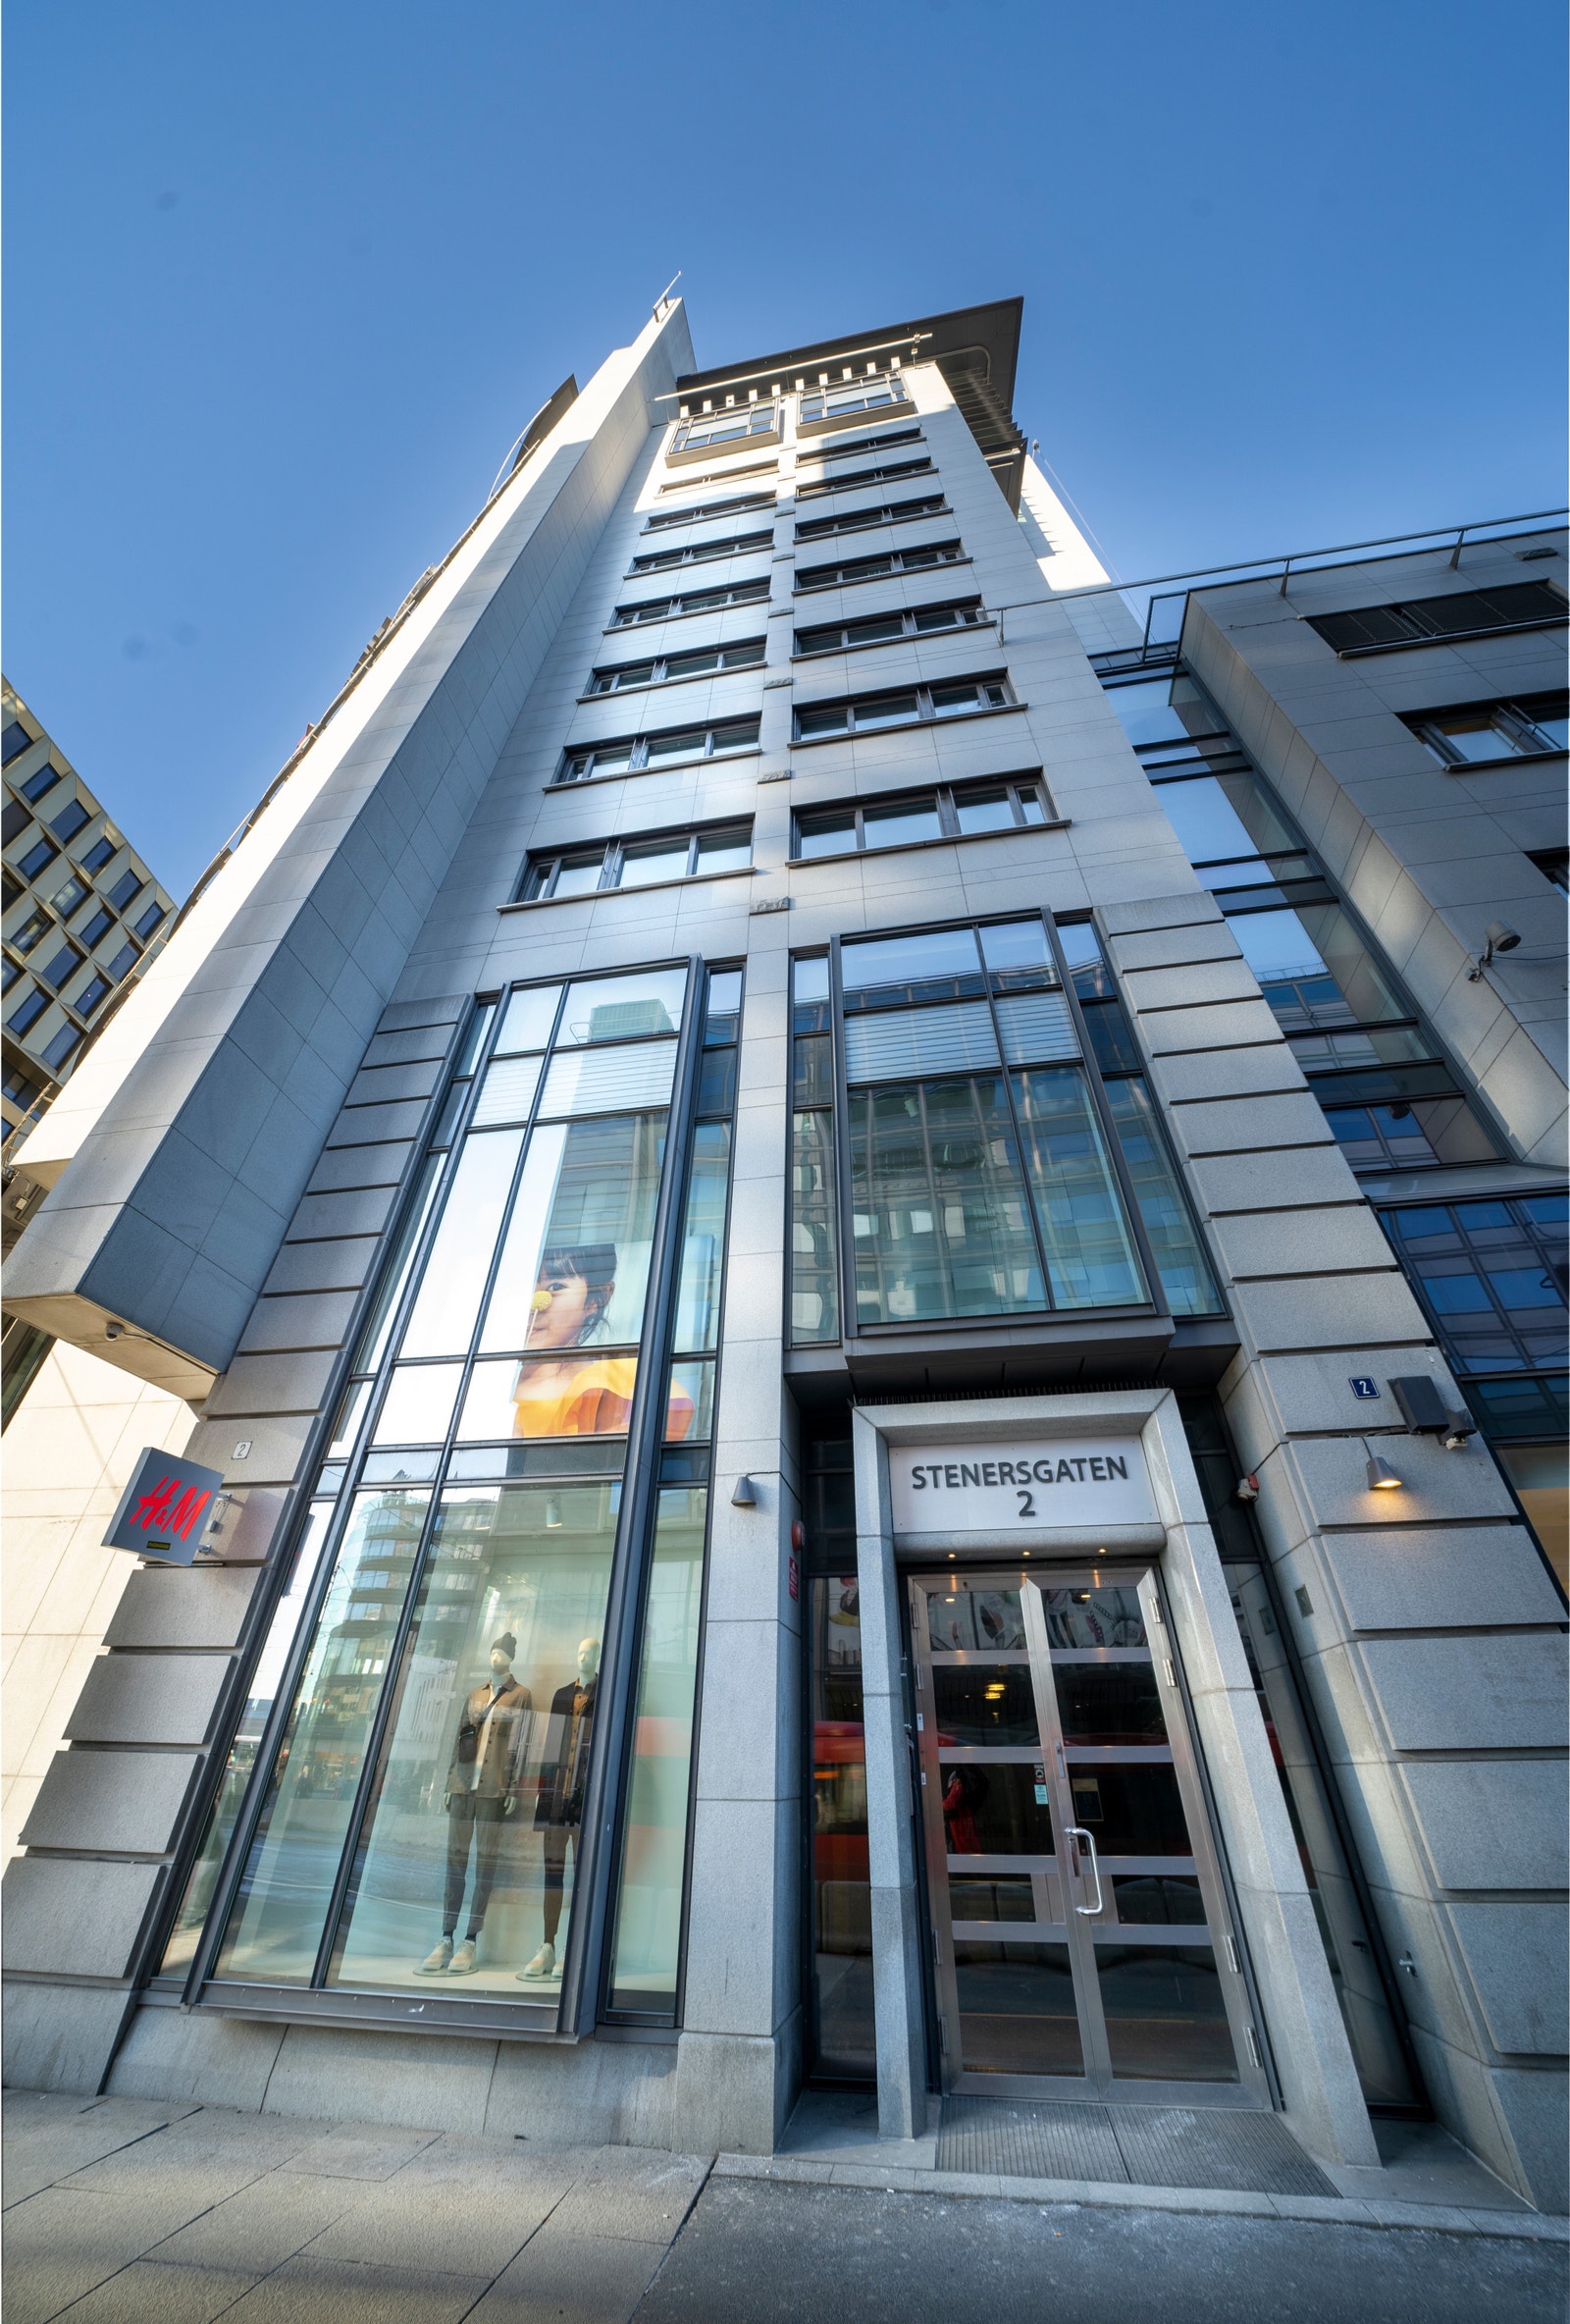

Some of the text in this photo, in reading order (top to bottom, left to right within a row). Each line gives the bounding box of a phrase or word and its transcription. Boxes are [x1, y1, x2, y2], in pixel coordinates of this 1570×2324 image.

[1359, 1380, 1371, 1395] 2
[236, 1444, 246, 1456] 2
[912, 1455, 1129, 1490] STENERSGATEN
[129, 1475, 213, 1543] H&M
[1016, 1490, 1036, 1517] 2
